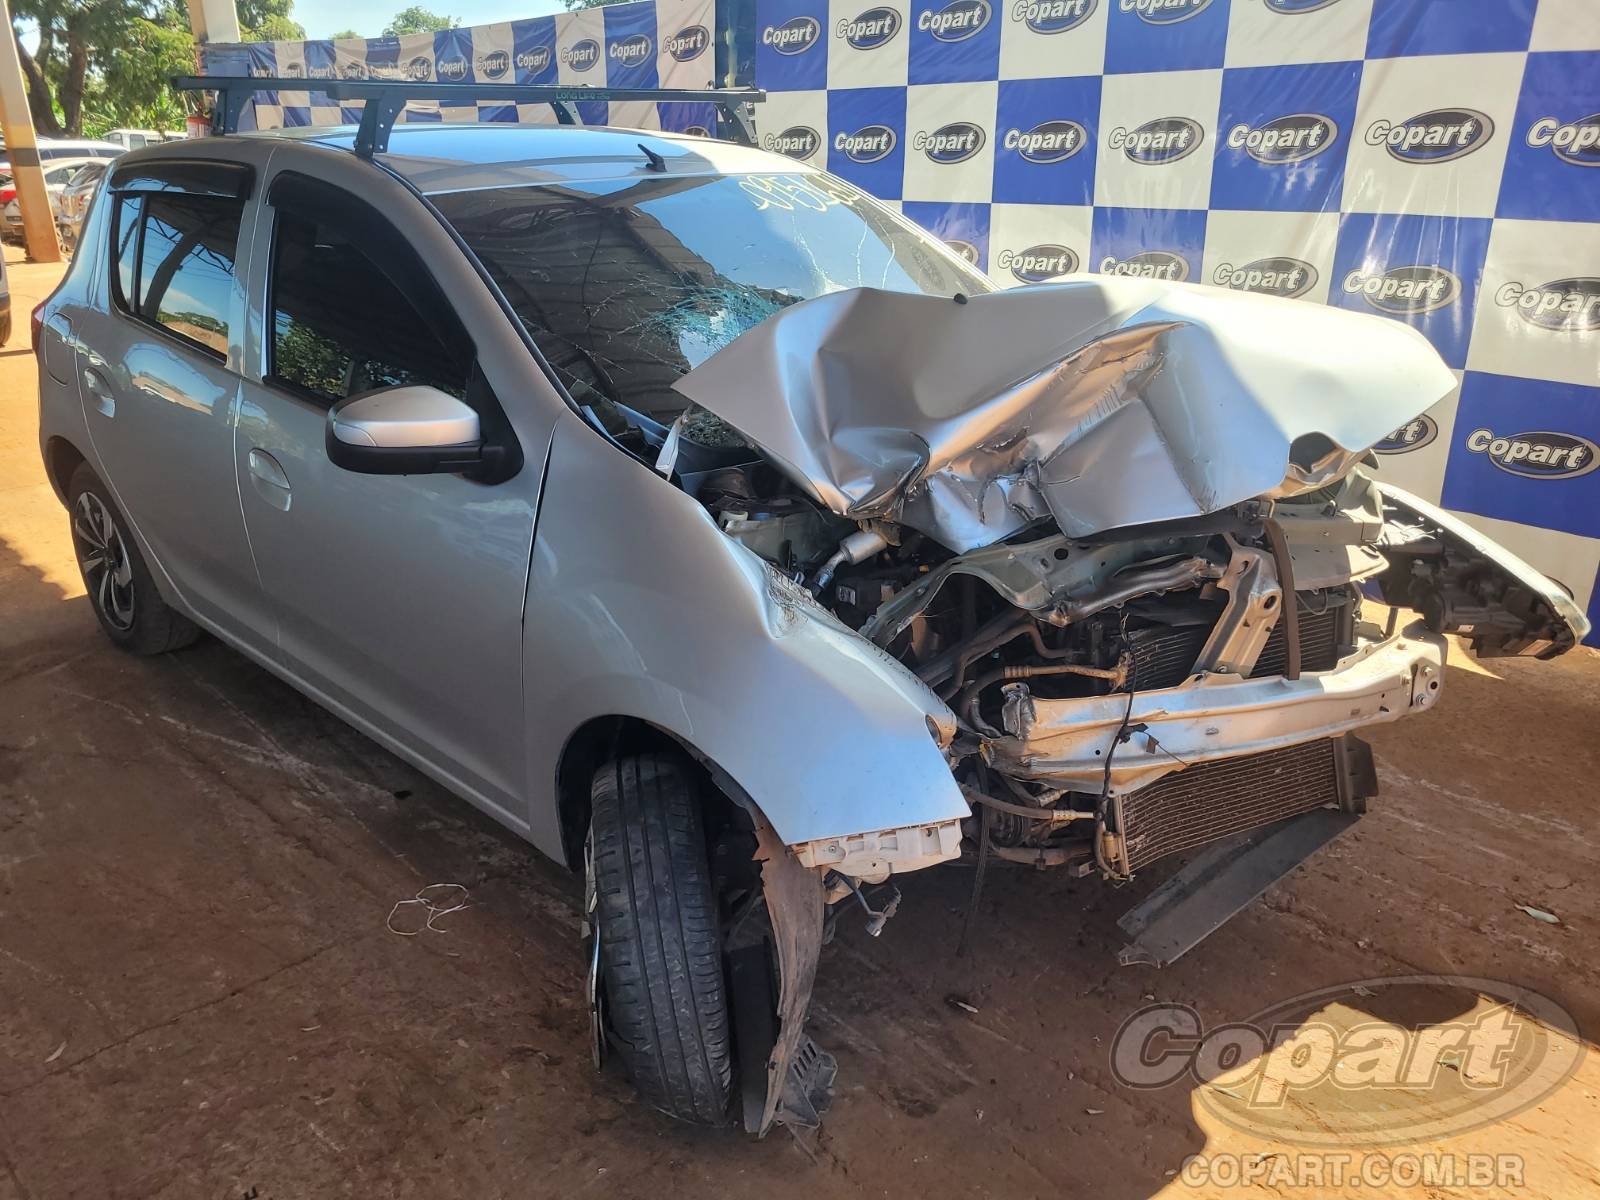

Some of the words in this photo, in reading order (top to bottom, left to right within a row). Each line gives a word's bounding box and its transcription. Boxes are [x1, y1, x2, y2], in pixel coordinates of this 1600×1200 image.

[836, 15, 892, 38] Copart
[918, 4, 983, 35] Copart
[664, 31, 704, 53] Copart
[763, 25, 814, 47] Copart
[517, 48, 548, 68] Copart
[561, 45, 595, 64] Copart
[610, 39, 647, 58] Copart
[438, 59, 466, 76] Copart
[477, 56, 505, 73] Copart
[764, 132, 812, 153] Copart
[834, 131, 889, 154] Copart
[913, 129, 977, 155] Copart
[1004, 125, 1079, 155] Copart
[1109, 126, 1194, 155] Copart
[1228, 121, 1325, 155] Copart
[1364, 116, 1476, 152] Copart
[1526, 116, 1600, 154] Cop
[998, 250, 1067, 273] Copart
[1213, 263, 1302, 291] Copart
[1343, 269, 1447, 300] Copart
[1495, 281, 1600, 315] Copar
[1466, 428, 1588, 469] Copart
